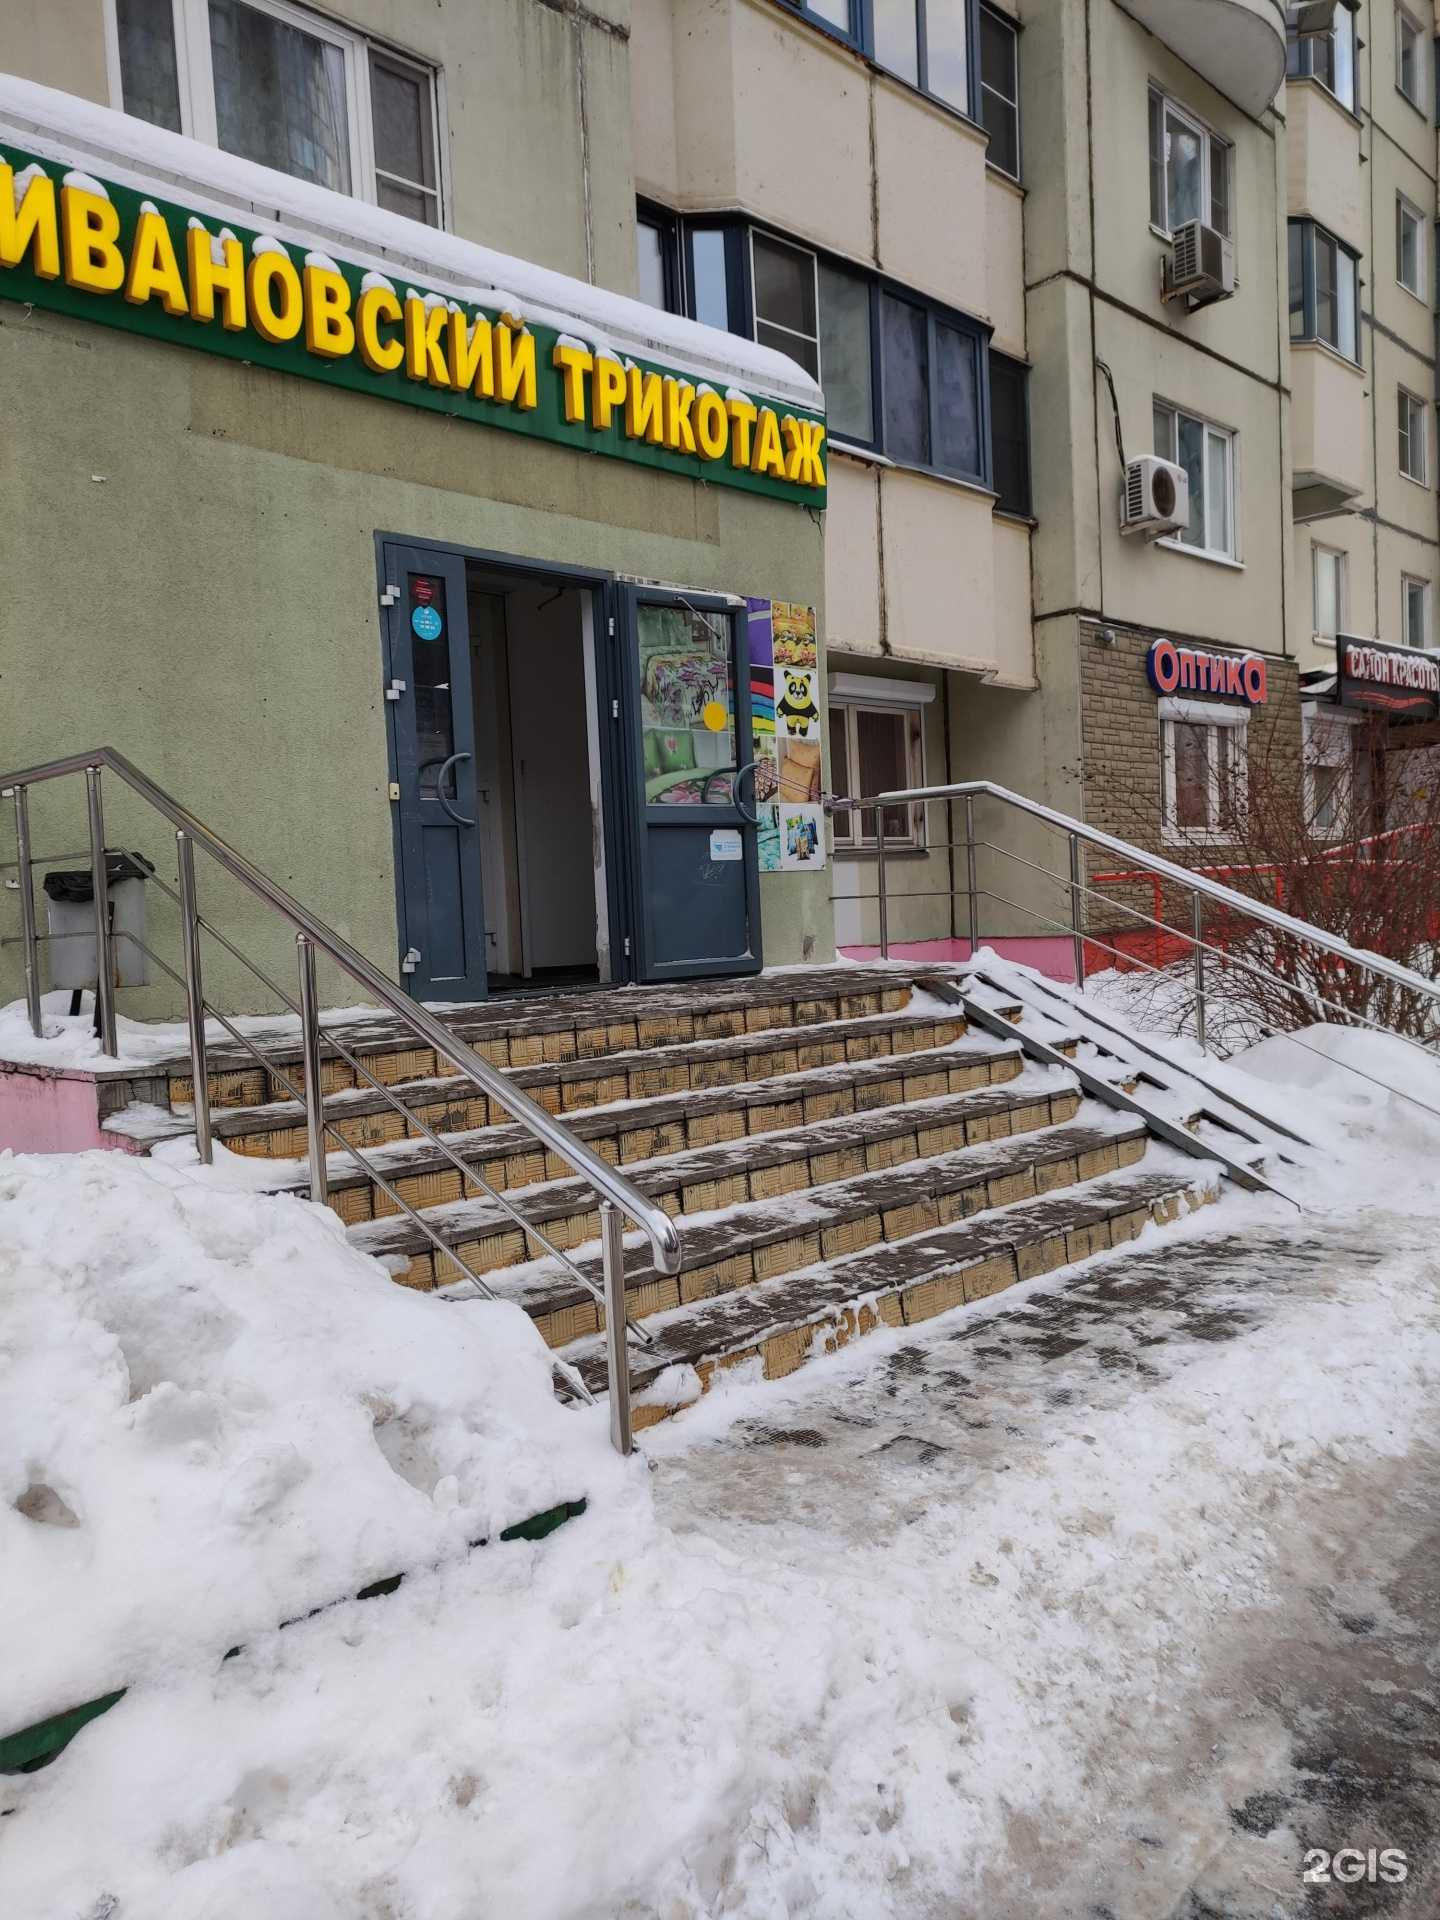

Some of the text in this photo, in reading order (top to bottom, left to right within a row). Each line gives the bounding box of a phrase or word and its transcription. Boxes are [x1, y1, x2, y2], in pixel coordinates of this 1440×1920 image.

[0, 163, 827, 487] ИВАНОВСКИЙ ТРИКОТАЖ
[1148, 641, 1266, 704] Оптика
[1391, 656, 1440, 692] КРАСОТЫ
